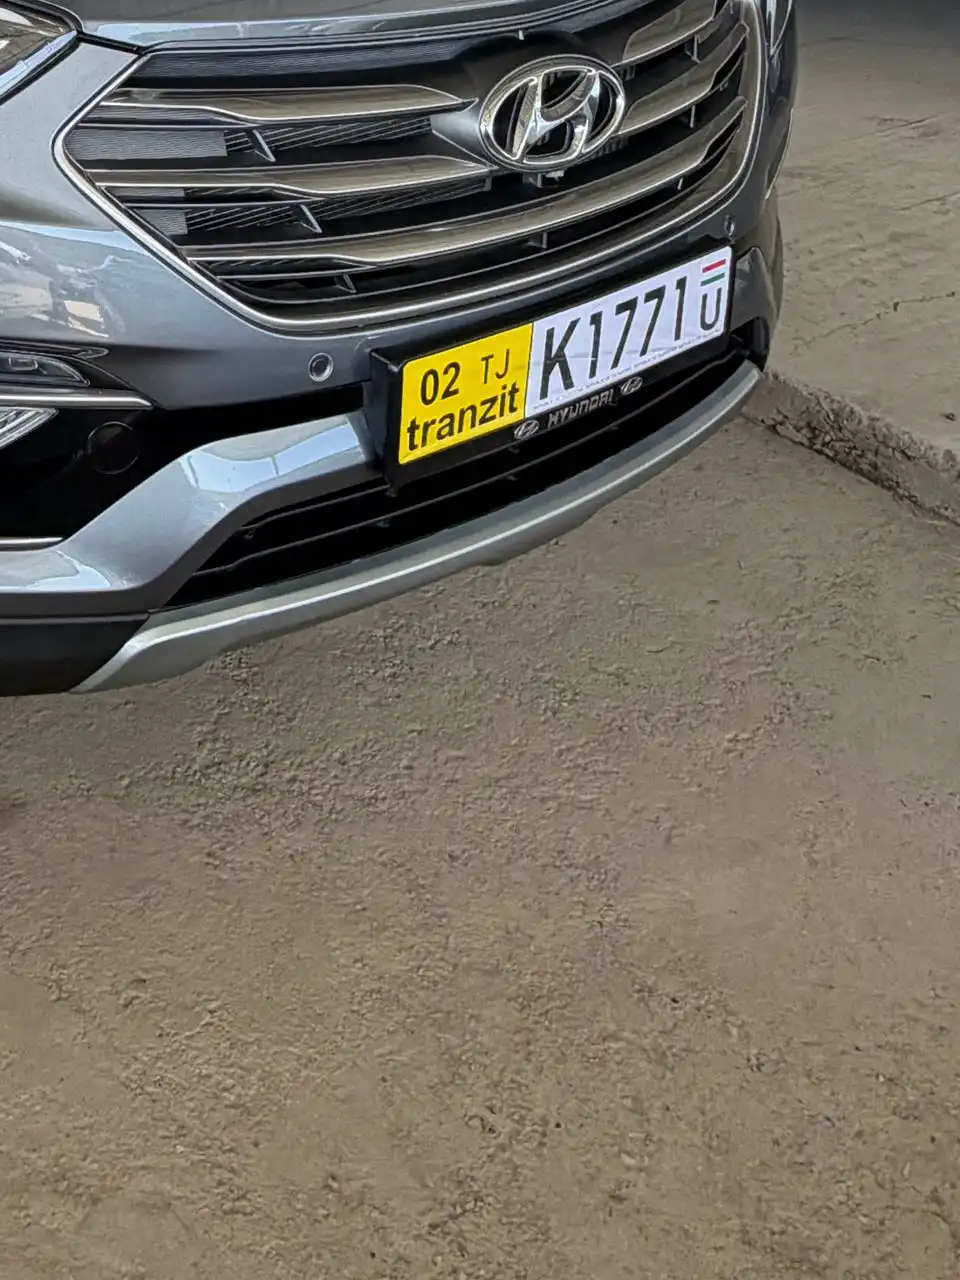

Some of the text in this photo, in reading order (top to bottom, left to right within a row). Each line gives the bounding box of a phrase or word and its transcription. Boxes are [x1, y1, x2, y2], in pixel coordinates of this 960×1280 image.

[539, 275, 688, 401] K1771
[699, 287, 723, 332] U
[420, 361, 461, 407] 02
[480, 348, 510, 385] TJ
[547, 389, 617, 429] HYUNDAI
[407, 381, 520, 452] tranzit
